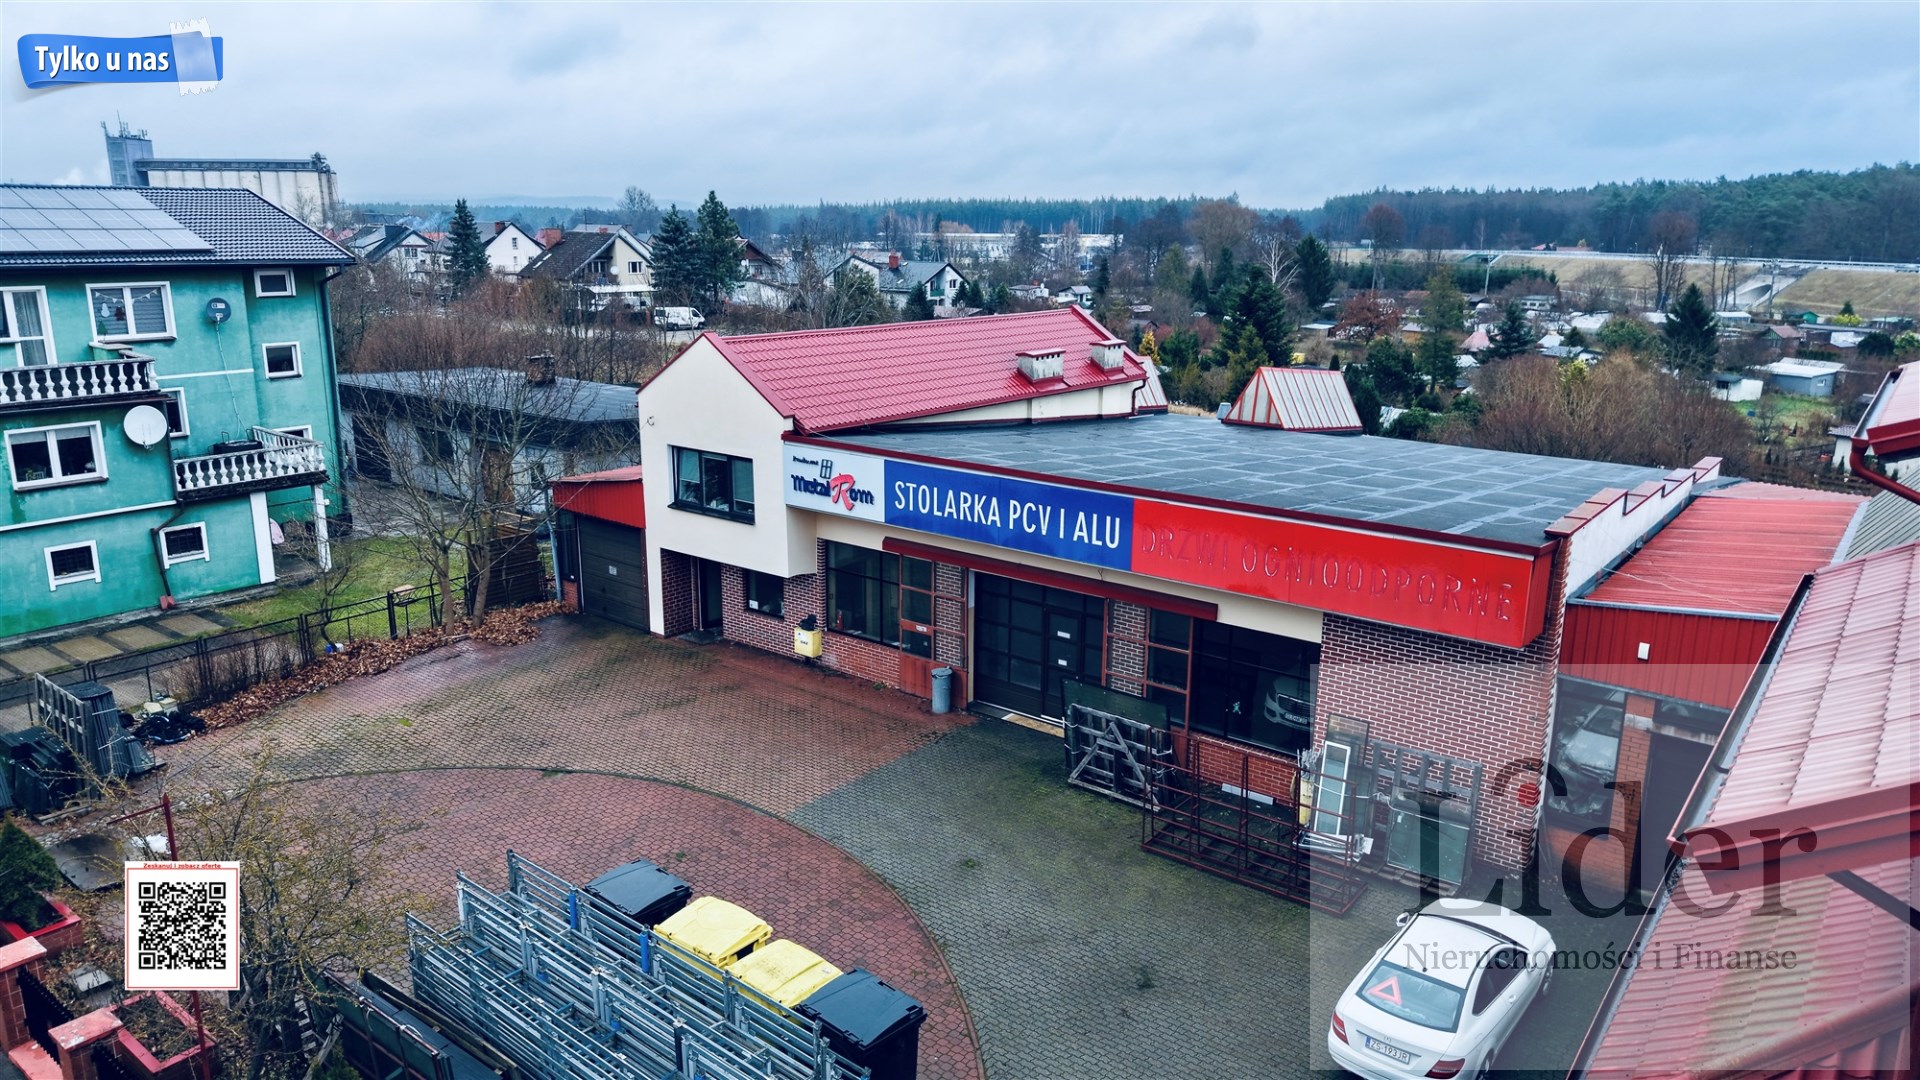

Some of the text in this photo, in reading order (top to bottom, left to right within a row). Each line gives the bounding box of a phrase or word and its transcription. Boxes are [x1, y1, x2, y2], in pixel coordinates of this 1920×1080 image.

[894, 480, 1121, 549] STOLARKA PCV I ALU
[1141, 522, 1513, 620] DRZWI OGNIOODPORNE
